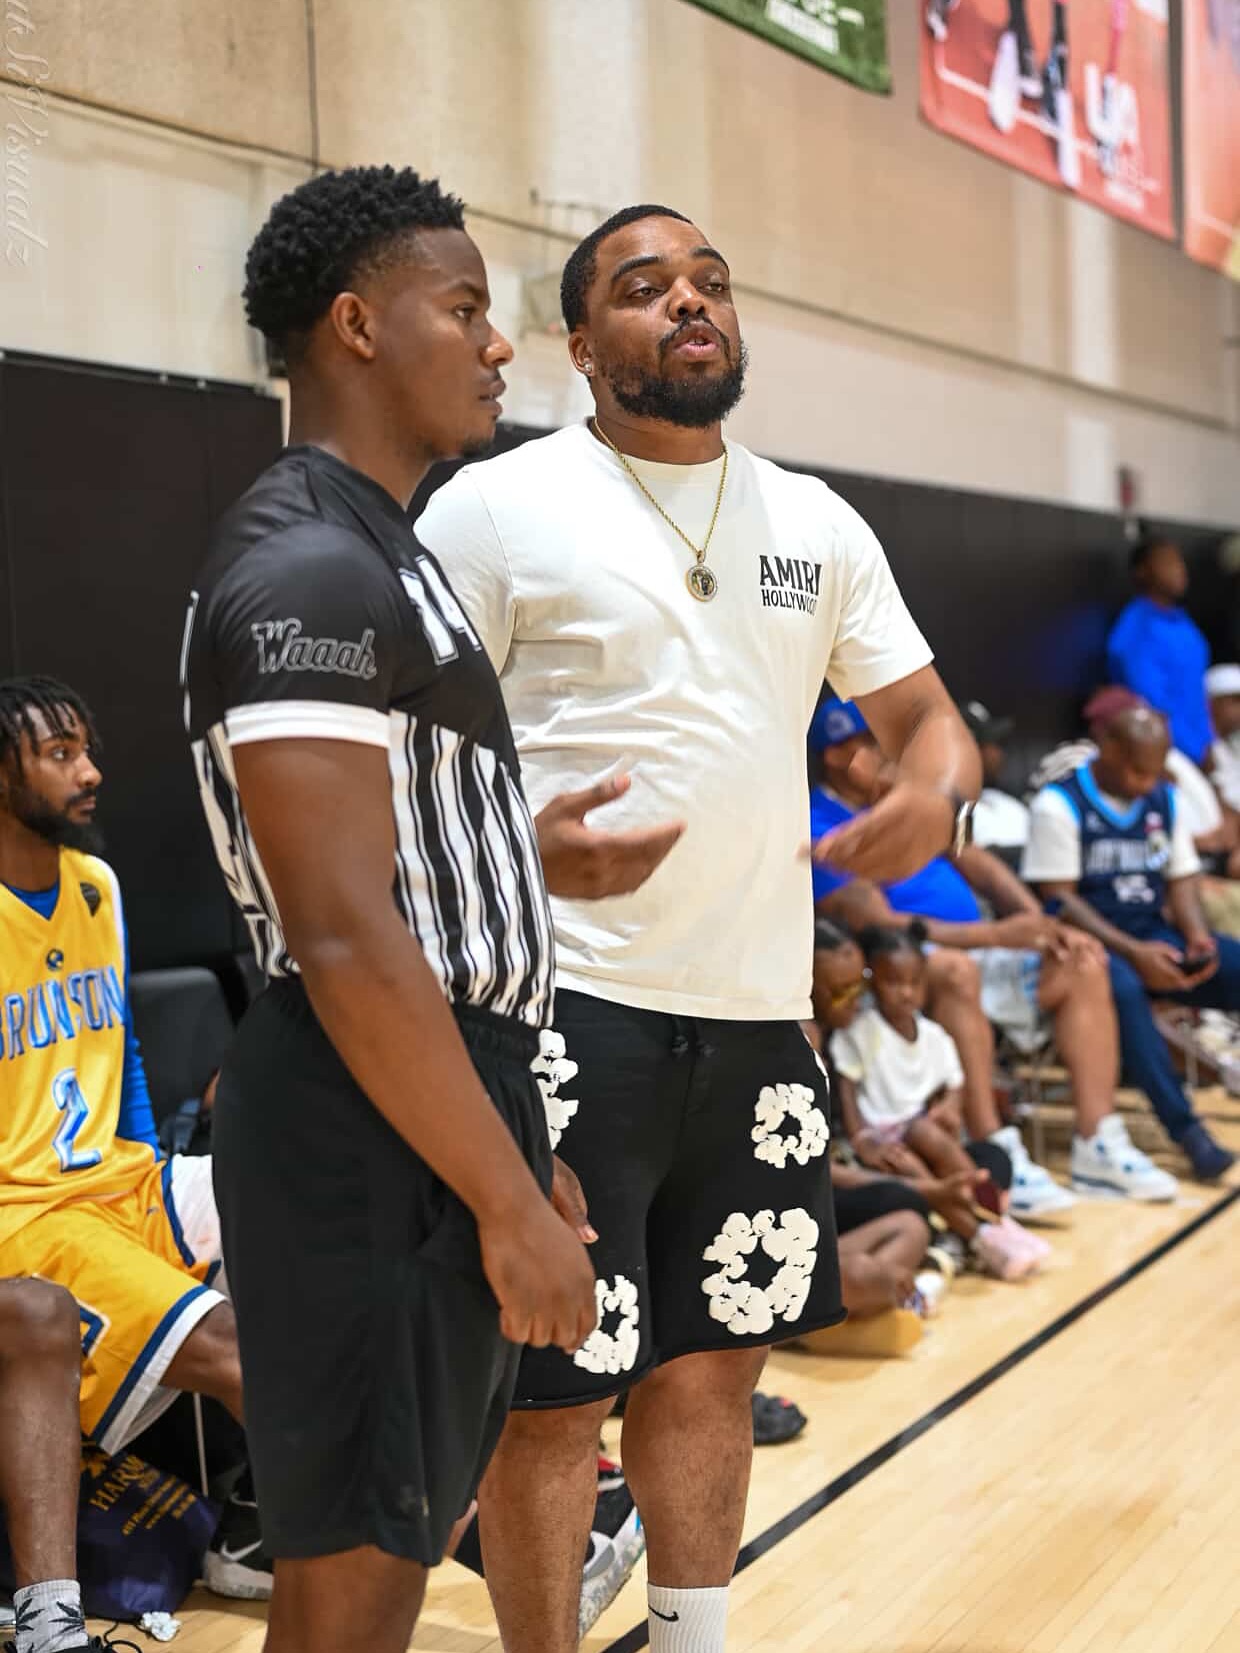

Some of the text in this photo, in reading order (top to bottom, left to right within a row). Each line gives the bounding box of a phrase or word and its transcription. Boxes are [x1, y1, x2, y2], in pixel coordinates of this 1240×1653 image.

[759, 554, 822, 597] AMIRI
[0, 965, 125, 1060] RUNSON
[52, 1067, 102, 1174] 2
